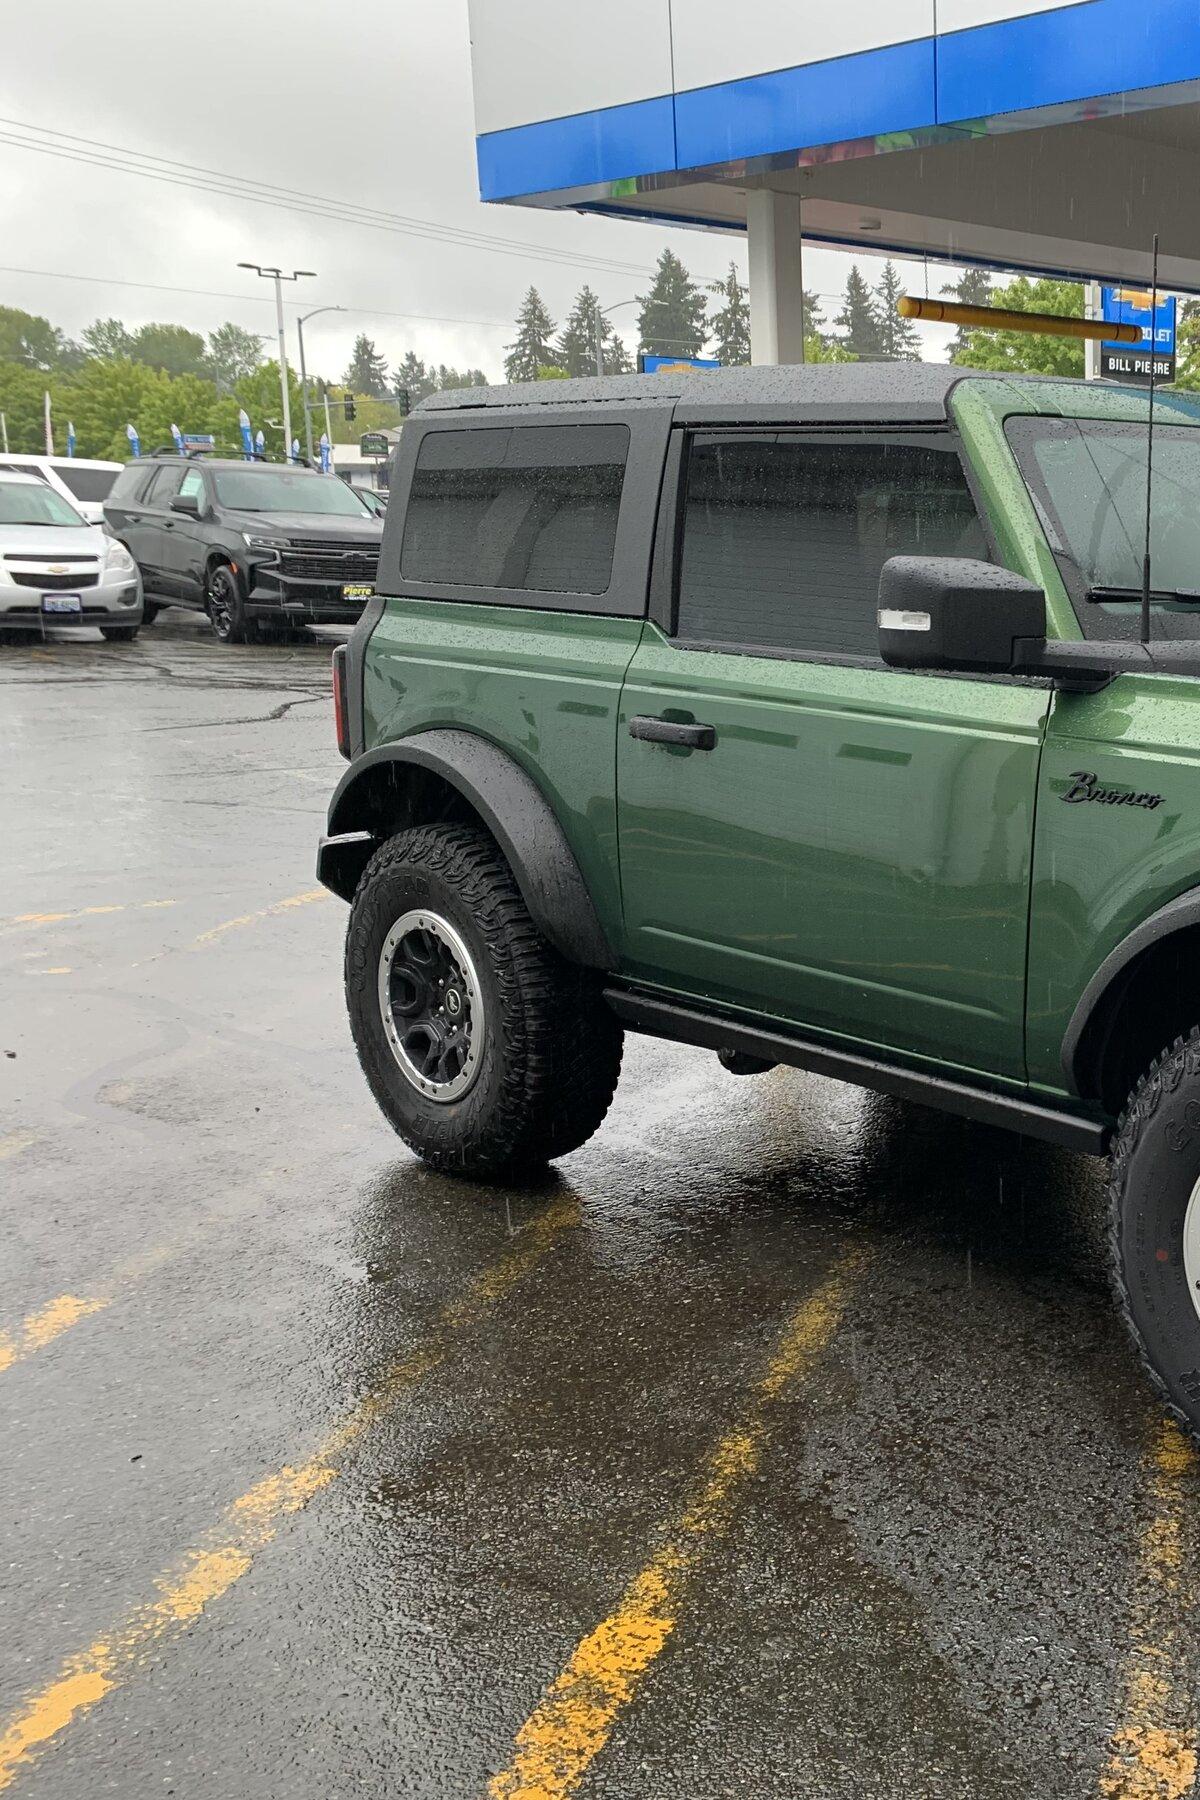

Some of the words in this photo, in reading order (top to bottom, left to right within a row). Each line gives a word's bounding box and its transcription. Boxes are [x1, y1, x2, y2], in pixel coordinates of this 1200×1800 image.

[1108, 357, 1131, 372] BILL
[343, 586, 372, 595] Pierre
[1058, 770, 1167, 810] Bronco
